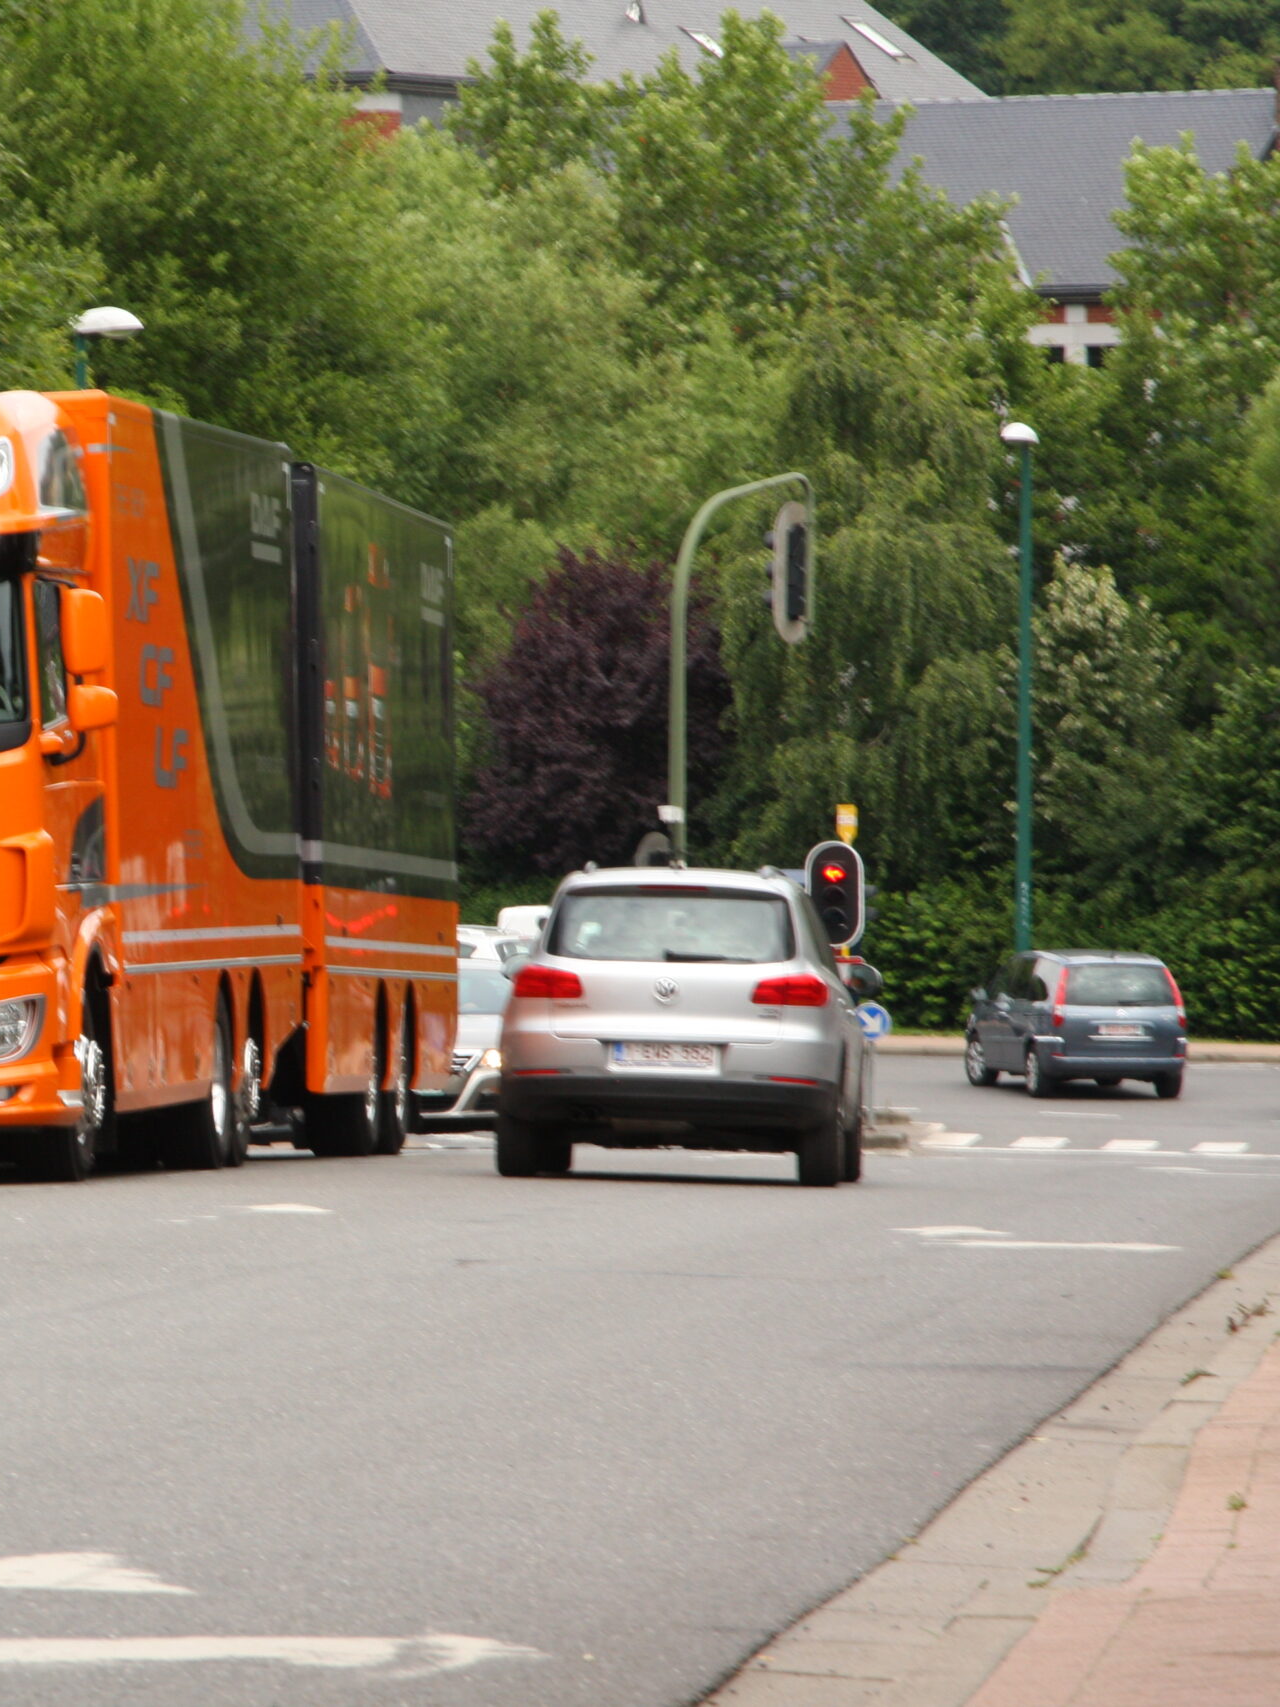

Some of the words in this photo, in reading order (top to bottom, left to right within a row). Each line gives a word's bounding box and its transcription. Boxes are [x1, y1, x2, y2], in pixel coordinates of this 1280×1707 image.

[250, 492, 282, 538] DAF
[125, 555, 160, 624] XF
[140, 643, 176, 708] CF
[154, 725, 190, 789] LF
